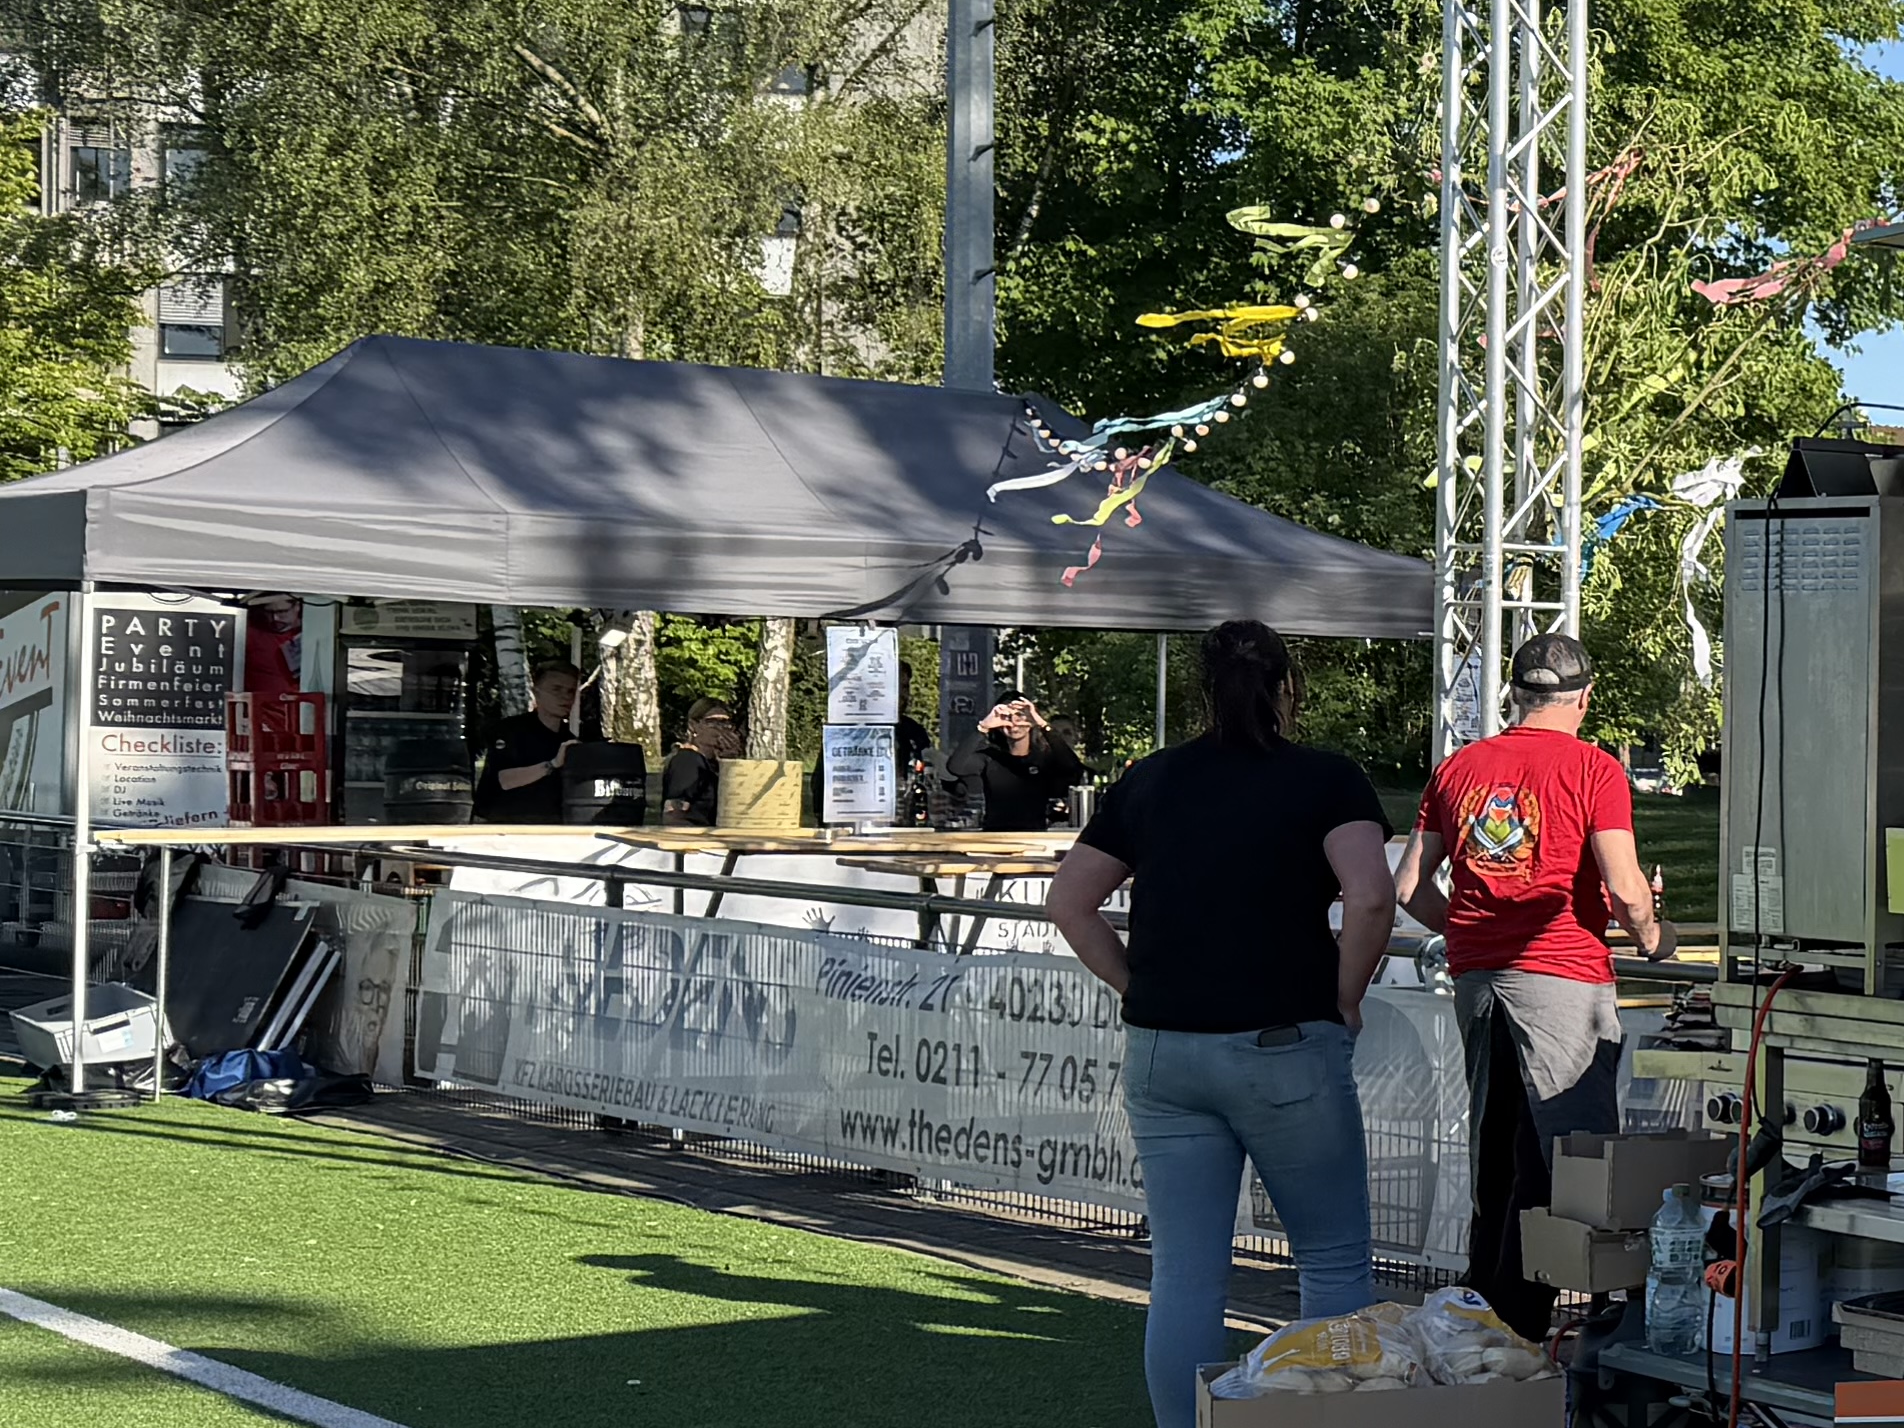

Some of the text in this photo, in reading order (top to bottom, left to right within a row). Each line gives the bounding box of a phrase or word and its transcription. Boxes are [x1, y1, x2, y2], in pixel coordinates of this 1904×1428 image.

[101, 615, 226, 638] PARTY
[101, 637, 224, 658] Event
[99, 657, 223, 675] Jubiläum
[98, 675, 223, 691] Firmenfeier
[99, 694, 223, 709] Sommerfest
[98, 711, 222, 725] Weihnachtsmarkt
[101, 733, 222, 754] Checkliste:
[114, 786, 126, 794] DJ
[867, 1032, 904, 1079] Tel.
[916, 1037, 980, 1089] 0211
[1019, 1050, 1053, 1097] 77
[1059, 1055, 1097, 1103] 05
[538, 1066, 655, 1112] KAROSSERIEBAU
[670, 1087, 775, 1133] LACKIERUNG
